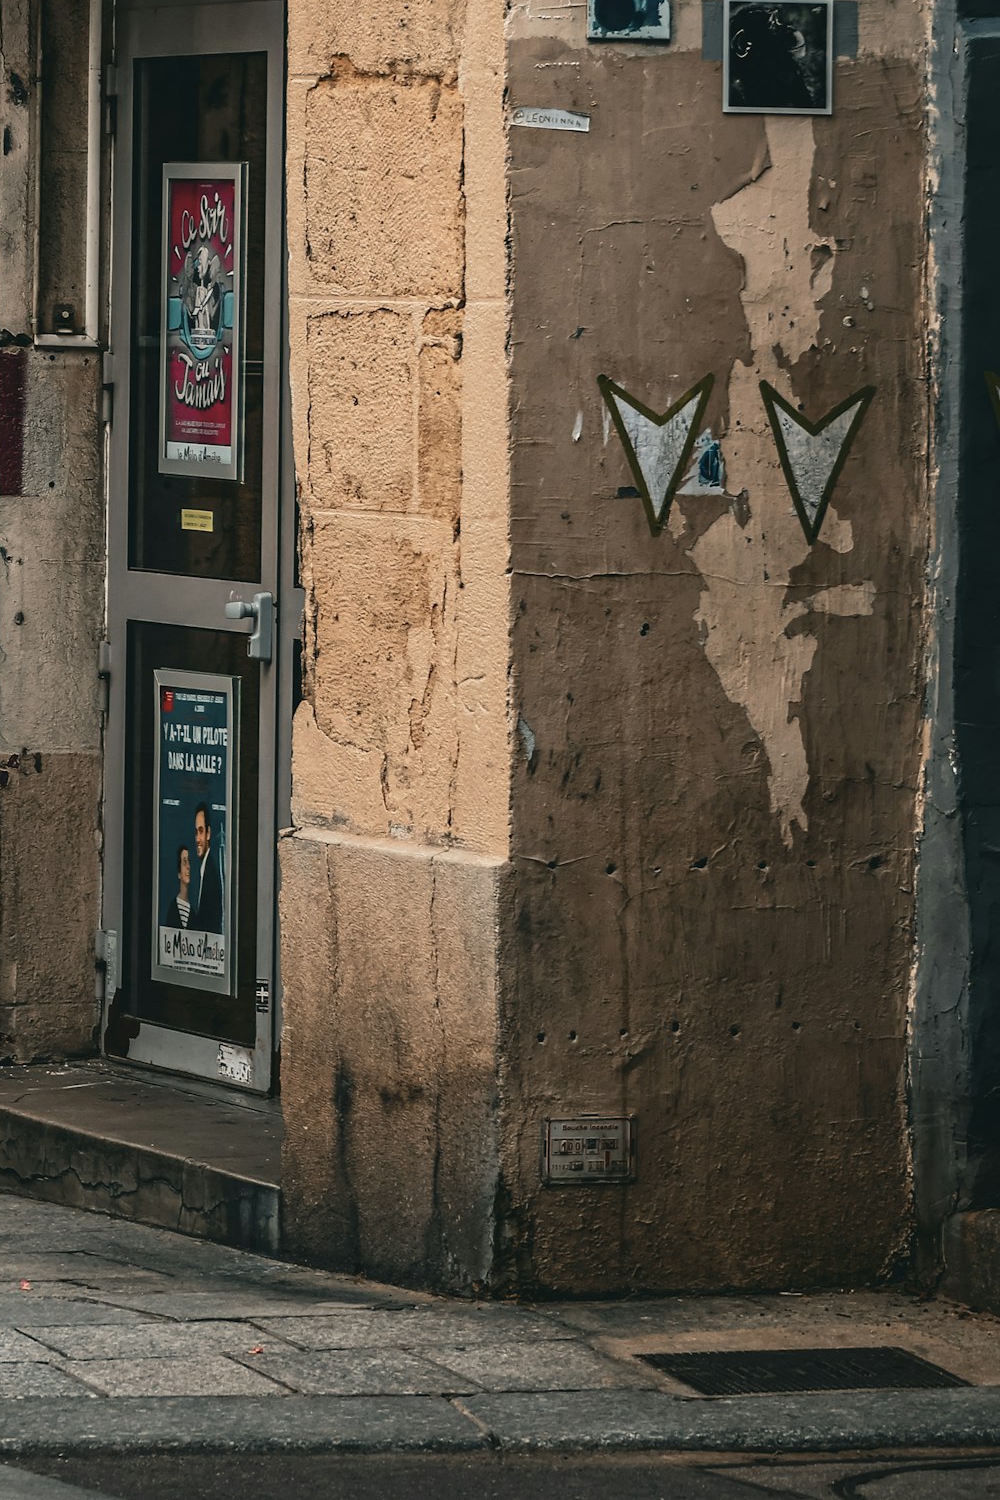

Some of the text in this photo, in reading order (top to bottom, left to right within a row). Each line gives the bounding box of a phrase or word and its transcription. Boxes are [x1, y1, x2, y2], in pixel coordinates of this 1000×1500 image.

[194, 362, 210, 382] ou
[193, 725, 202, 745] UN
[202, 727, 228, 747] PILOTE
[168, 751, 184, 770] DANS
[185, 752, 195, 772] LA
[196, 754, 216, 774] SALLE
[164, 934, 172, 954] le
